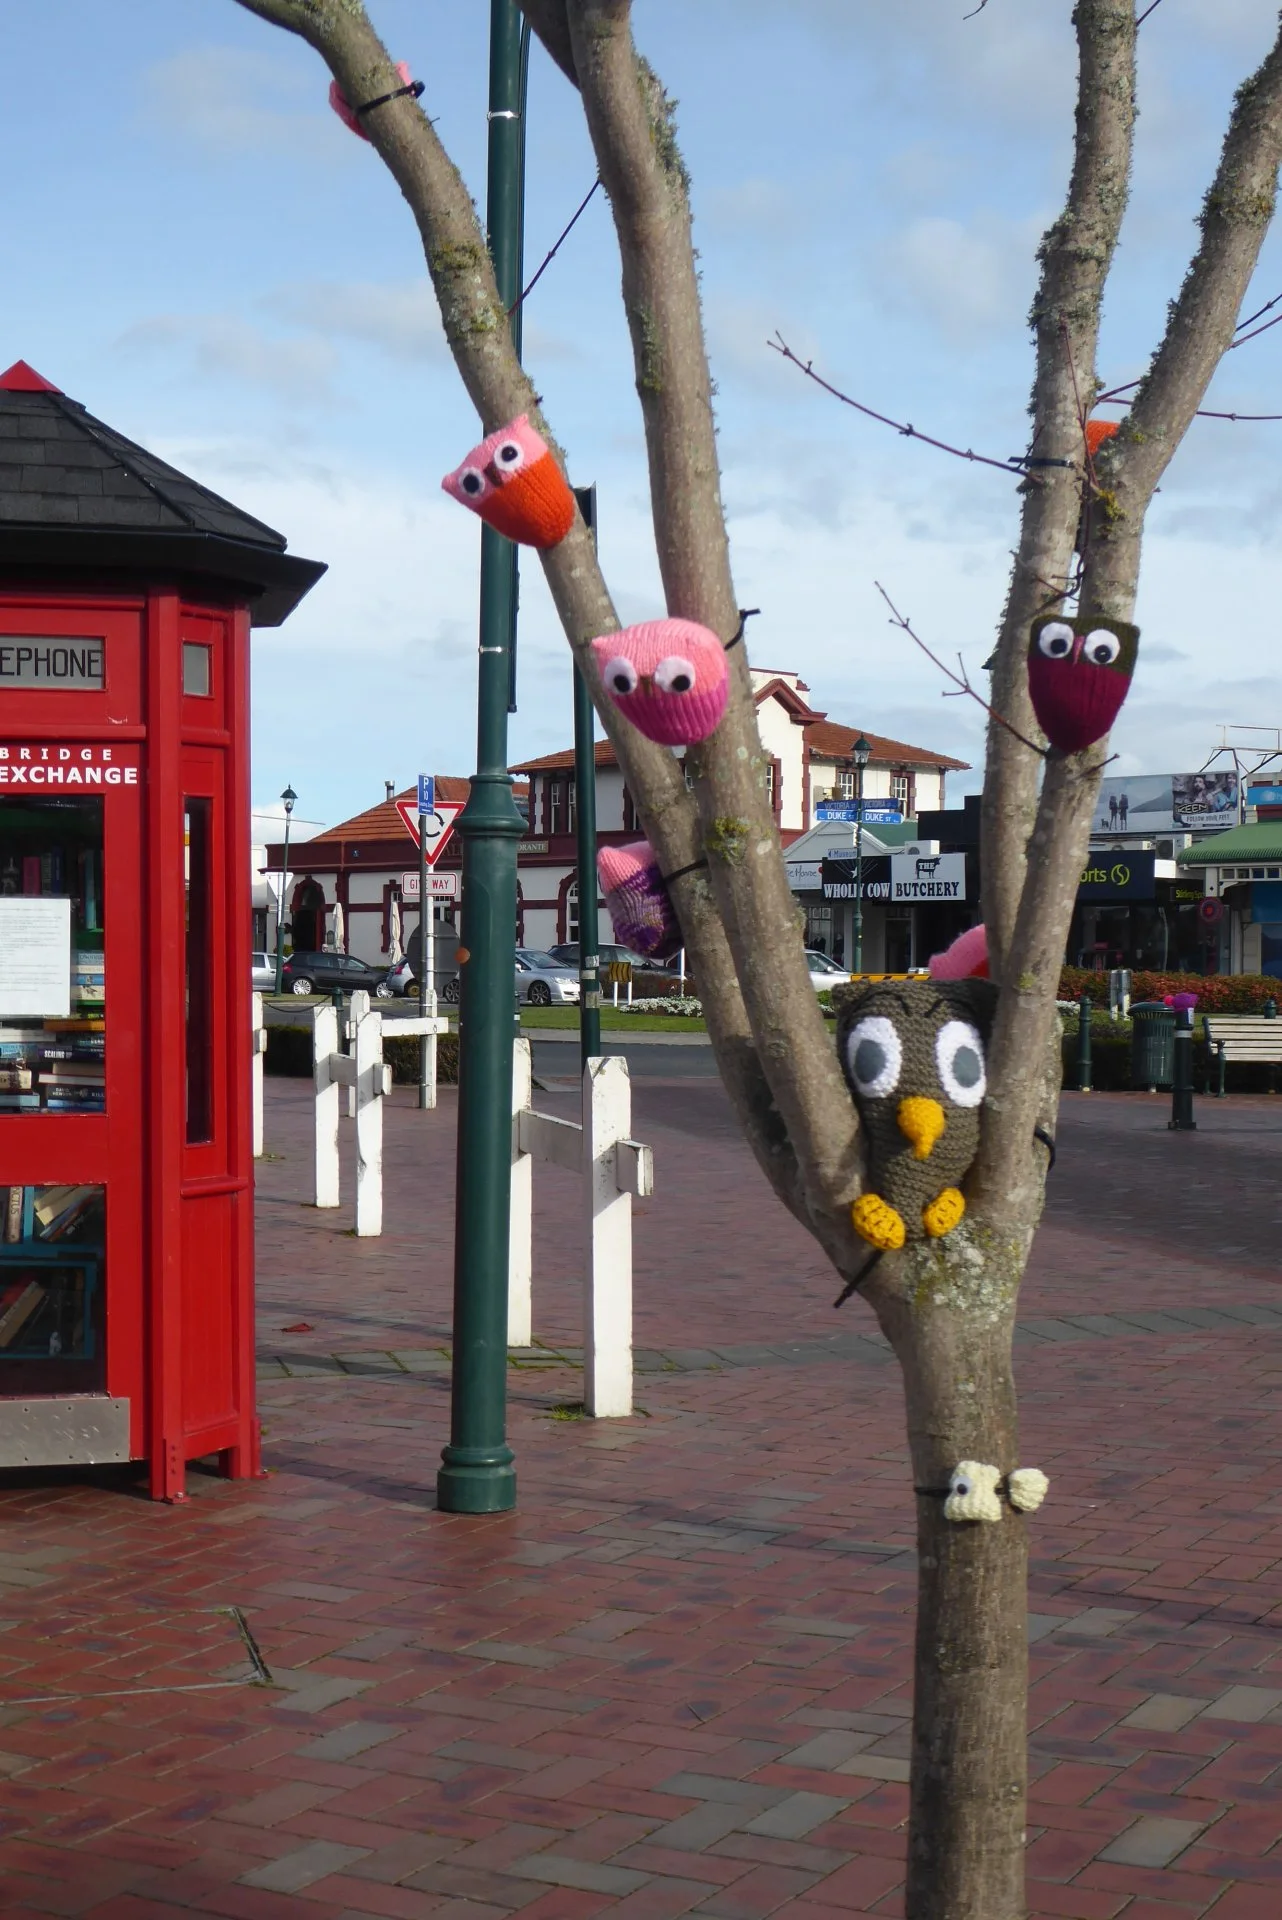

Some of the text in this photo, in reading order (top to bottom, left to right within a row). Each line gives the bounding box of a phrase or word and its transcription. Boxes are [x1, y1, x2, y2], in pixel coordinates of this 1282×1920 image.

[0, 647, 102, 677] EPHONE
[0, 747, 112, 760] BRIDGE
[0, 766, 137, 784] EXCHANGE
[423, 776, 429, 789] P
[423, 790, 429, 801] 10
[825, 801, 849, 810] VICTORIA
[864, 799, 886, 808] VICTORIA
[1178, 804, 1207, 813] KEEN
[827, 812, 846, 820] DUKE
[865, 813, 883, 822] DUKE
[918, 862, 935, 870] THE
[432, 879, 449, 889] WAY
[896, 881, 959, 897] BUTCHERY
[867, 882, 890, 898] COW
